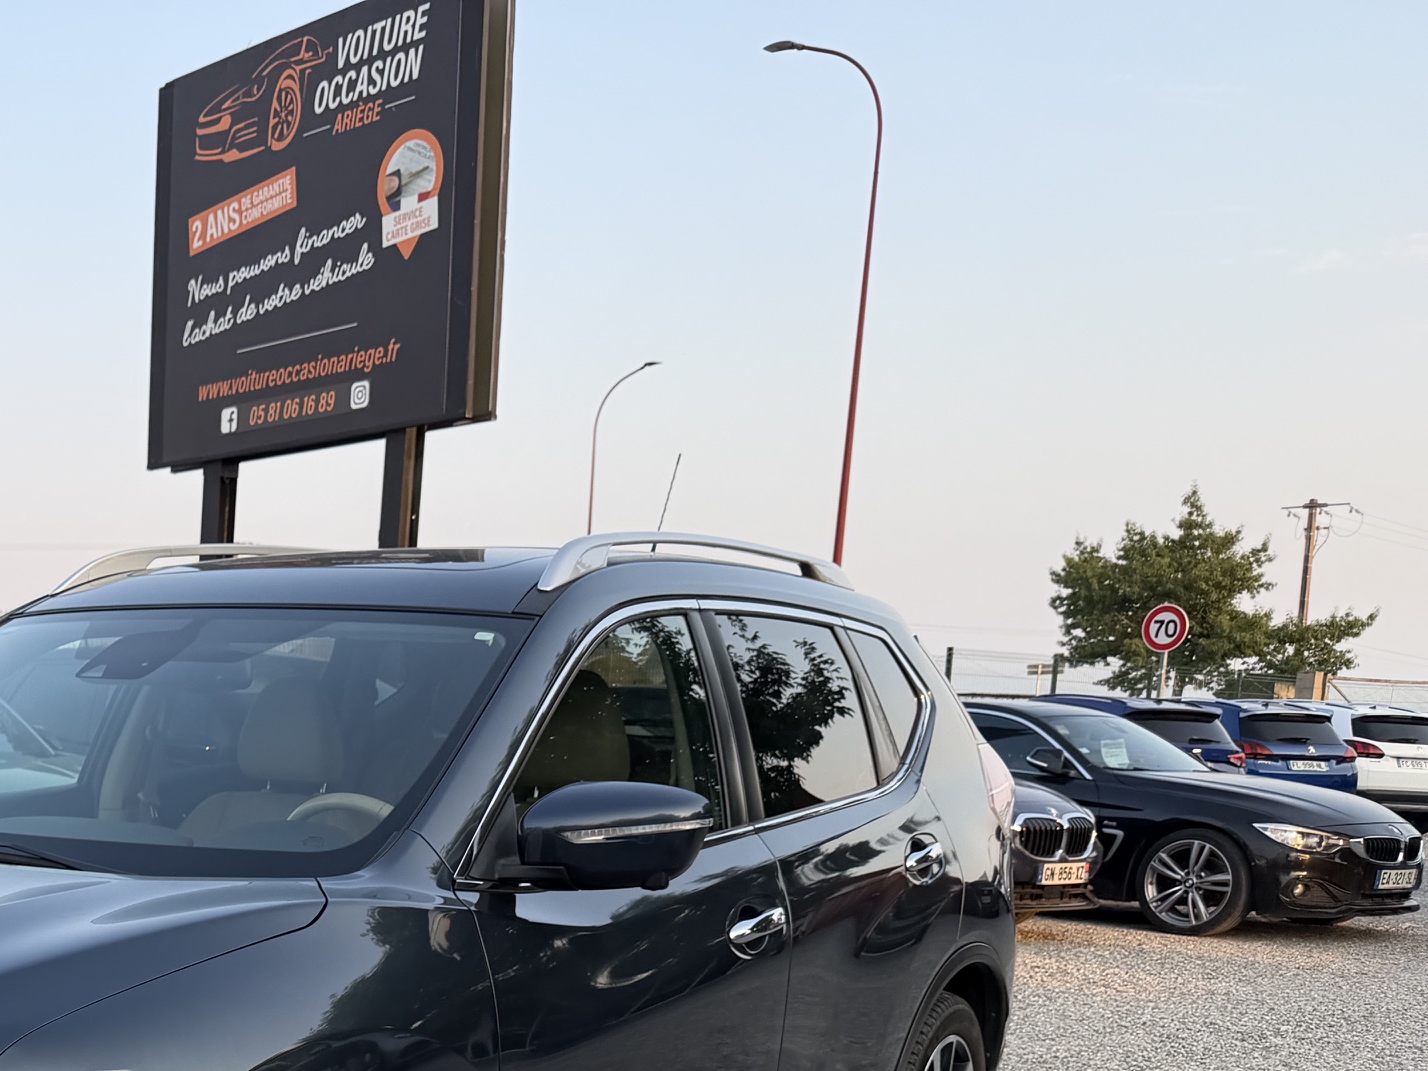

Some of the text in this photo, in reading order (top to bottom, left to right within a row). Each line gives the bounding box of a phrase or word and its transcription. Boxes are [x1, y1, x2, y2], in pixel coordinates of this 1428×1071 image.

[336, 4, 431, 70] VOITURE
[314, 44, 425, 115] OCCASION
[332, 99, 383, 136] ARIÈGE
[241, 175, 292, 211] DE GARANTIE
[192, 201, 241, 250] 2 ANS
[385, 216, 432, 243] CARTE GRISE
[392, 205, 424, 228] SERVICE
[187, 211, 367, 307] Nous pouvons financer
[182, 242, 375, 347] l'achat de votre véhicule
[197, 337, 402, 402] www.voitureoccasionariege.fr
[248, 390, 336, 426] 05 81 06 16 89
[1154, 619, 1178, 639] 70
